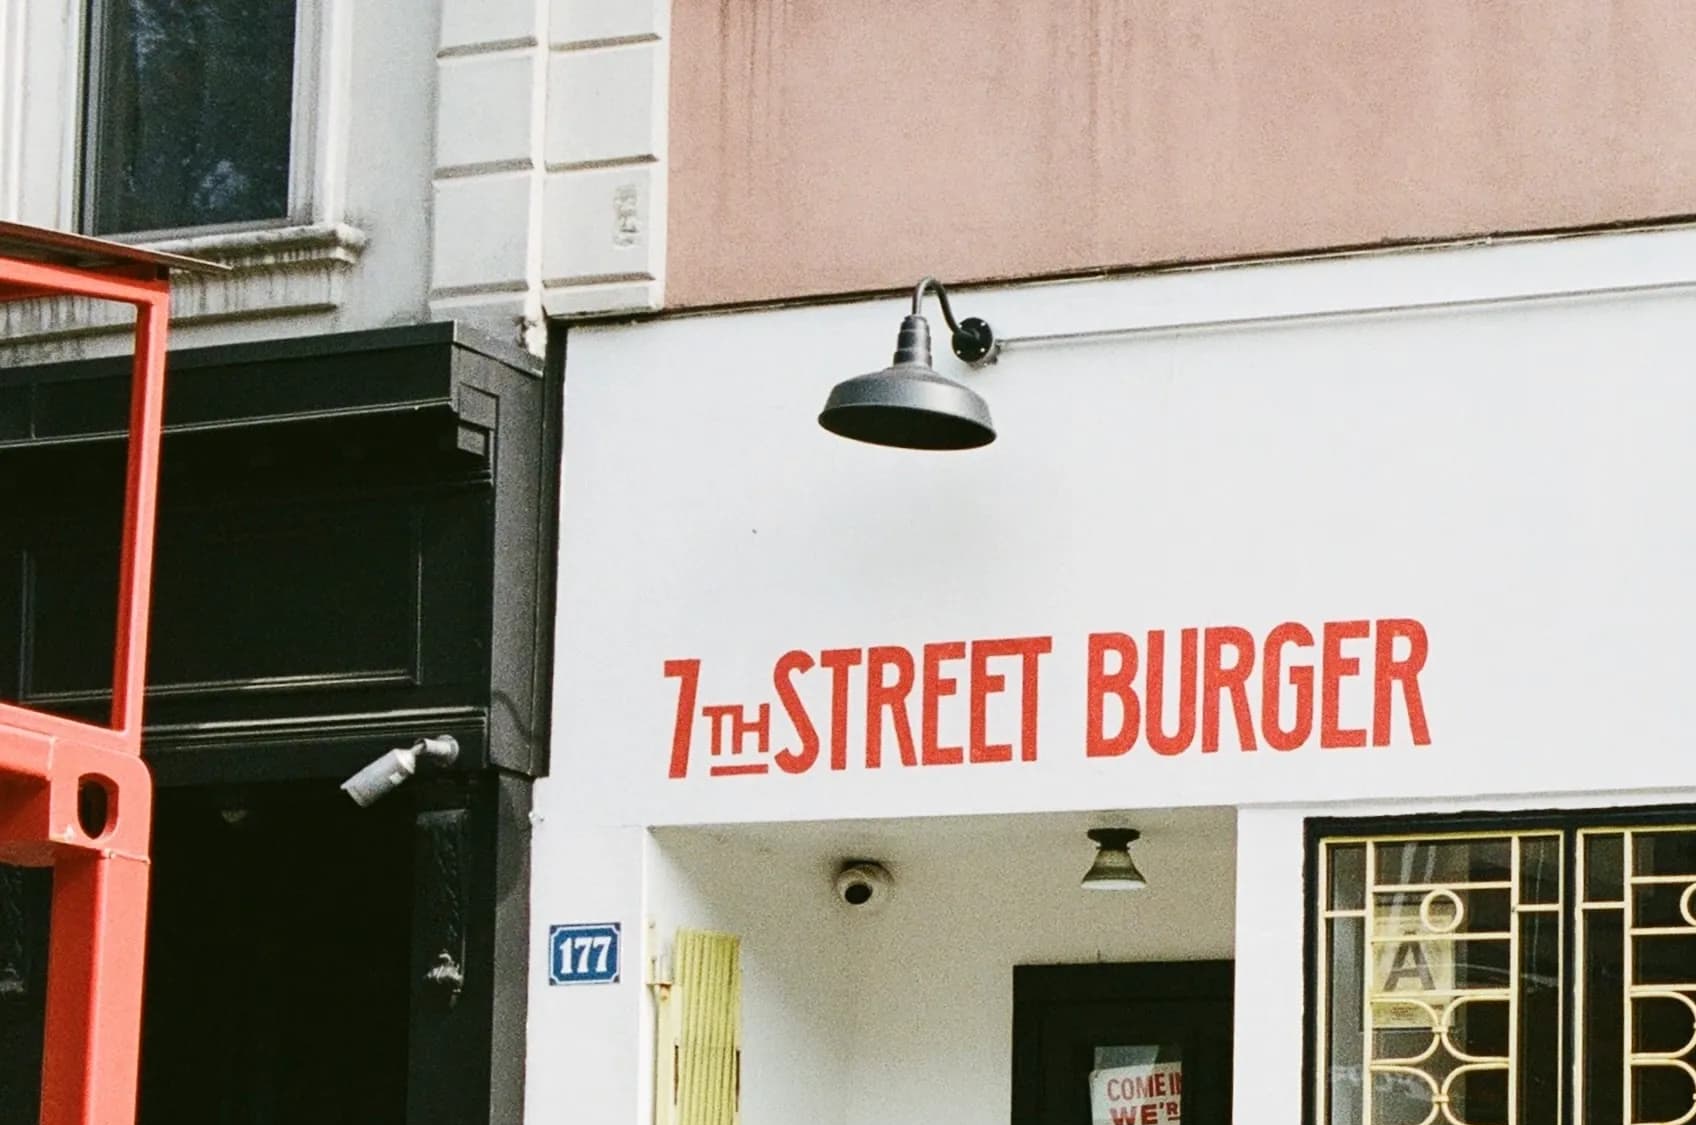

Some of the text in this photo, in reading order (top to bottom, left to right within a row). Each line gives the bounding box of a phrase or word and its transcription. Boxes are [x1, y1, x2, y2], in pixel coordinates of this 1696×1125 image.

[773, 635, 1052, 774] STREET
[1086, 618, 1431, 758] BURGER
[560, 936, 612, 974] 177
[1383, 940, 1437, 992] A
[1107, 1073, 1166, 1101] COME
